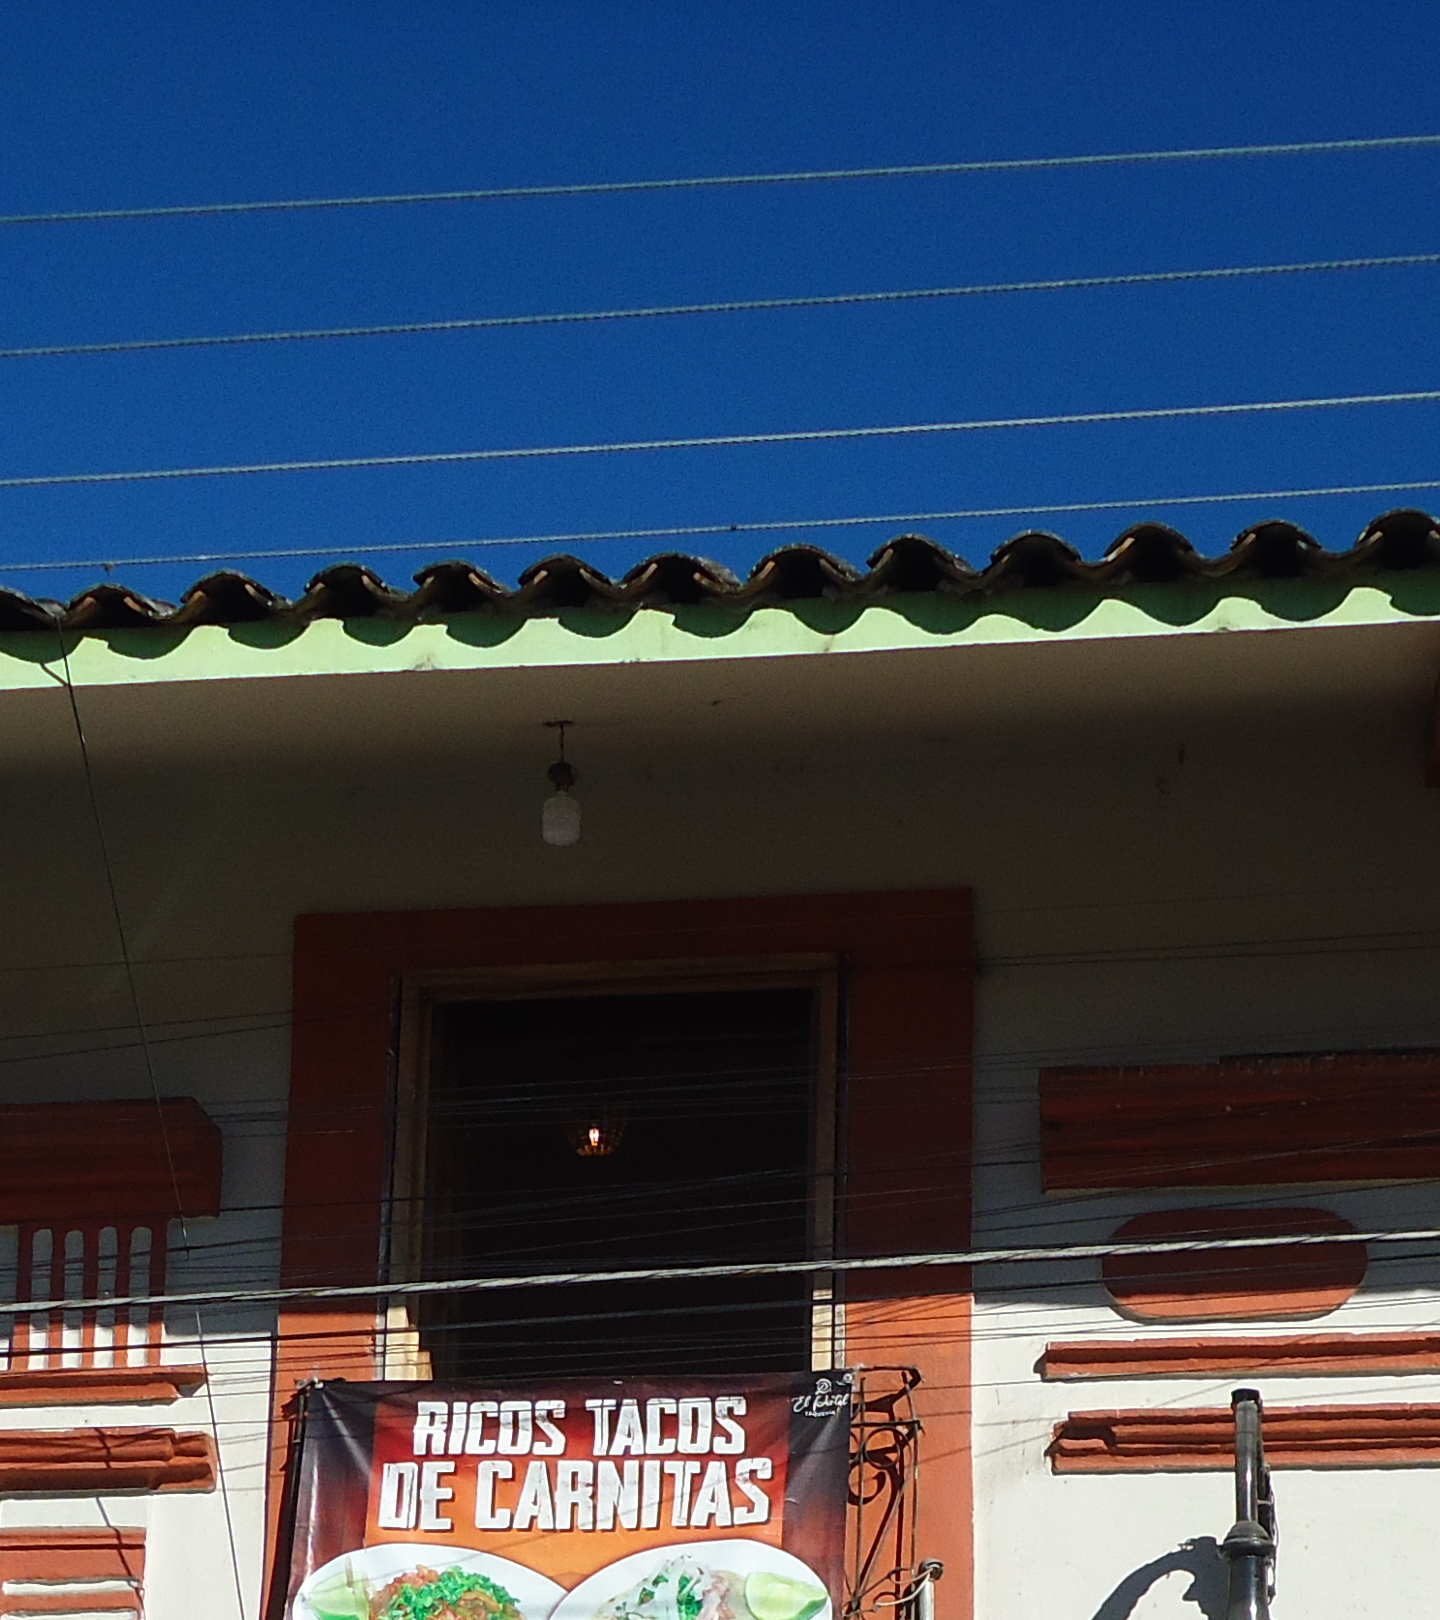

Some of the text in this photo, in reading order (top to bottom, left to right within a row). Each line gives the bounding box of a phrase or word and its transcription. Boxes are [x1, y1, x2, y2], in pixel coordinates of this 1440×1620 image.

[412, 1395, 747, 1456] RICOS TACOS
[377, 1457, 773, 1531] DE CARNITAS
